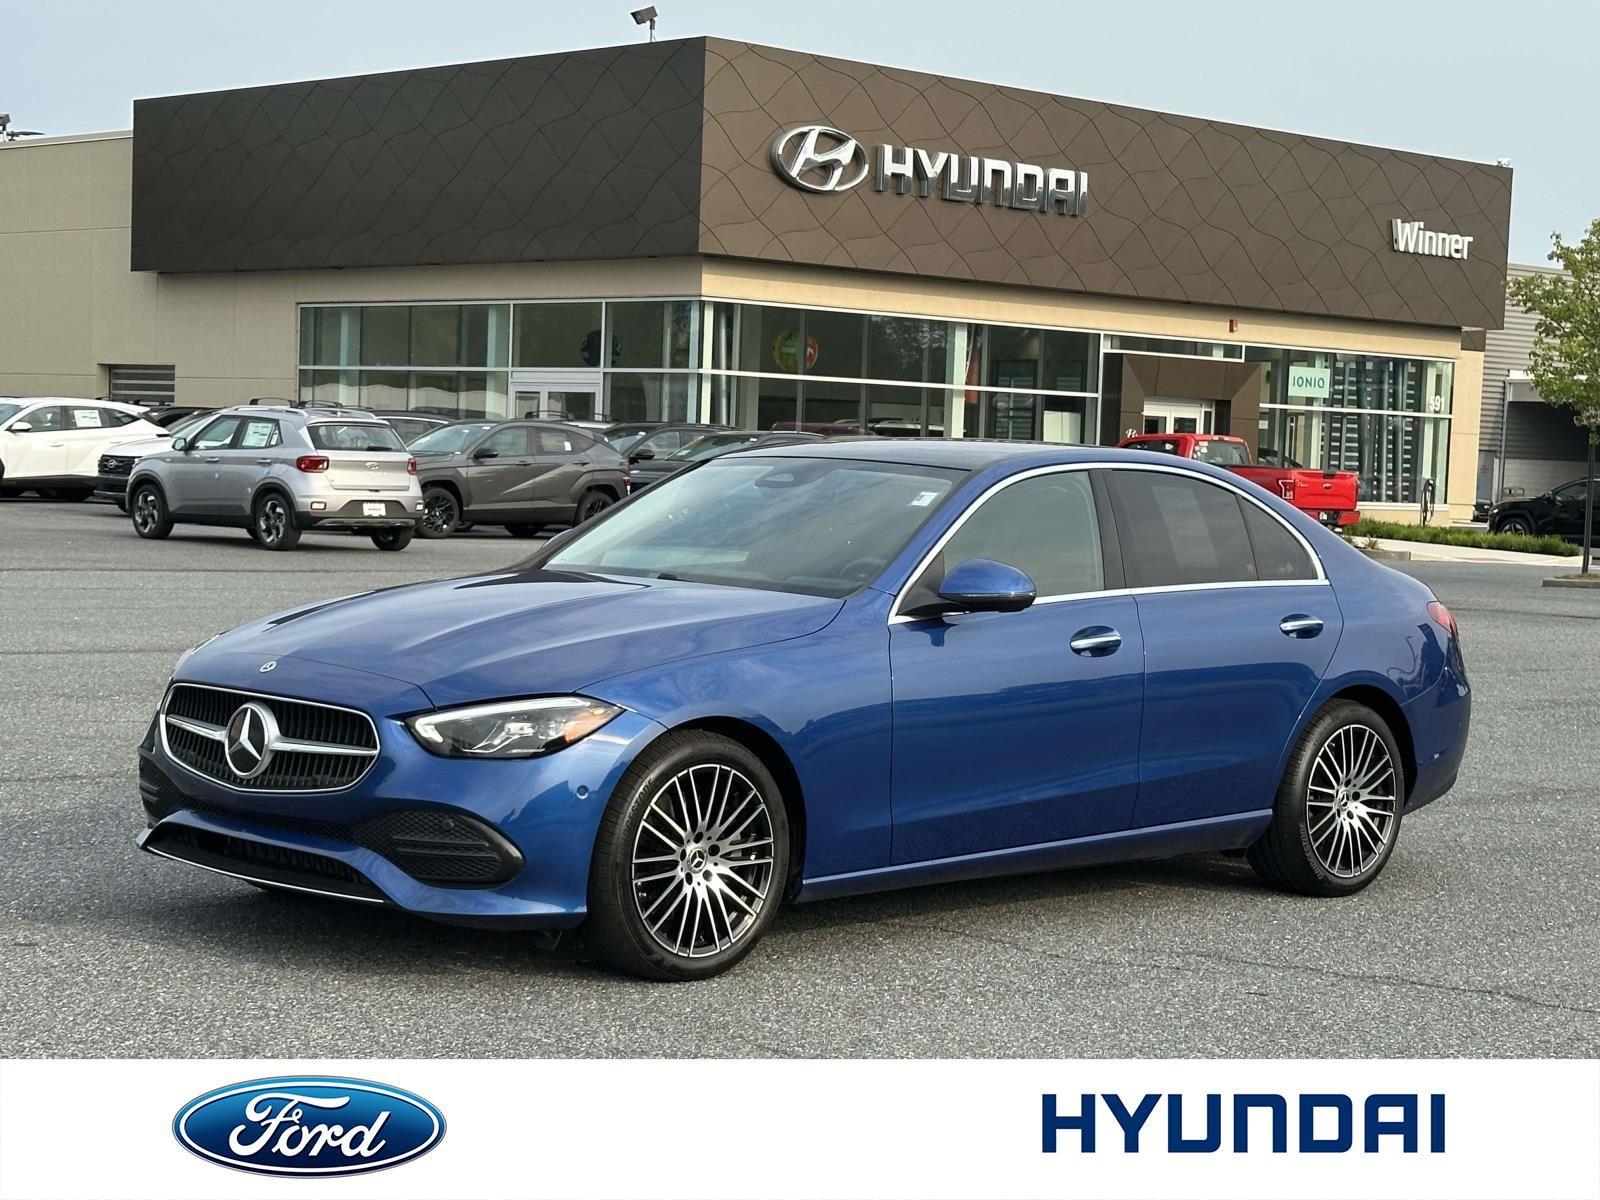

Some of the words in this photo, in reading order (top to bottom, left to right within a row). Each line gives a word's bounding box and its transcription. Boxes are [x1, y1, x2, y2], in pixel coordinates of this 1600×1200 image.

[875, 143, 1089, 216] HYUNDAI
[1391, 218, 1474, 260] Winner
[1292, 375, 1325, 390] IONIQ
[1429, 395, 1446, 411] 591
